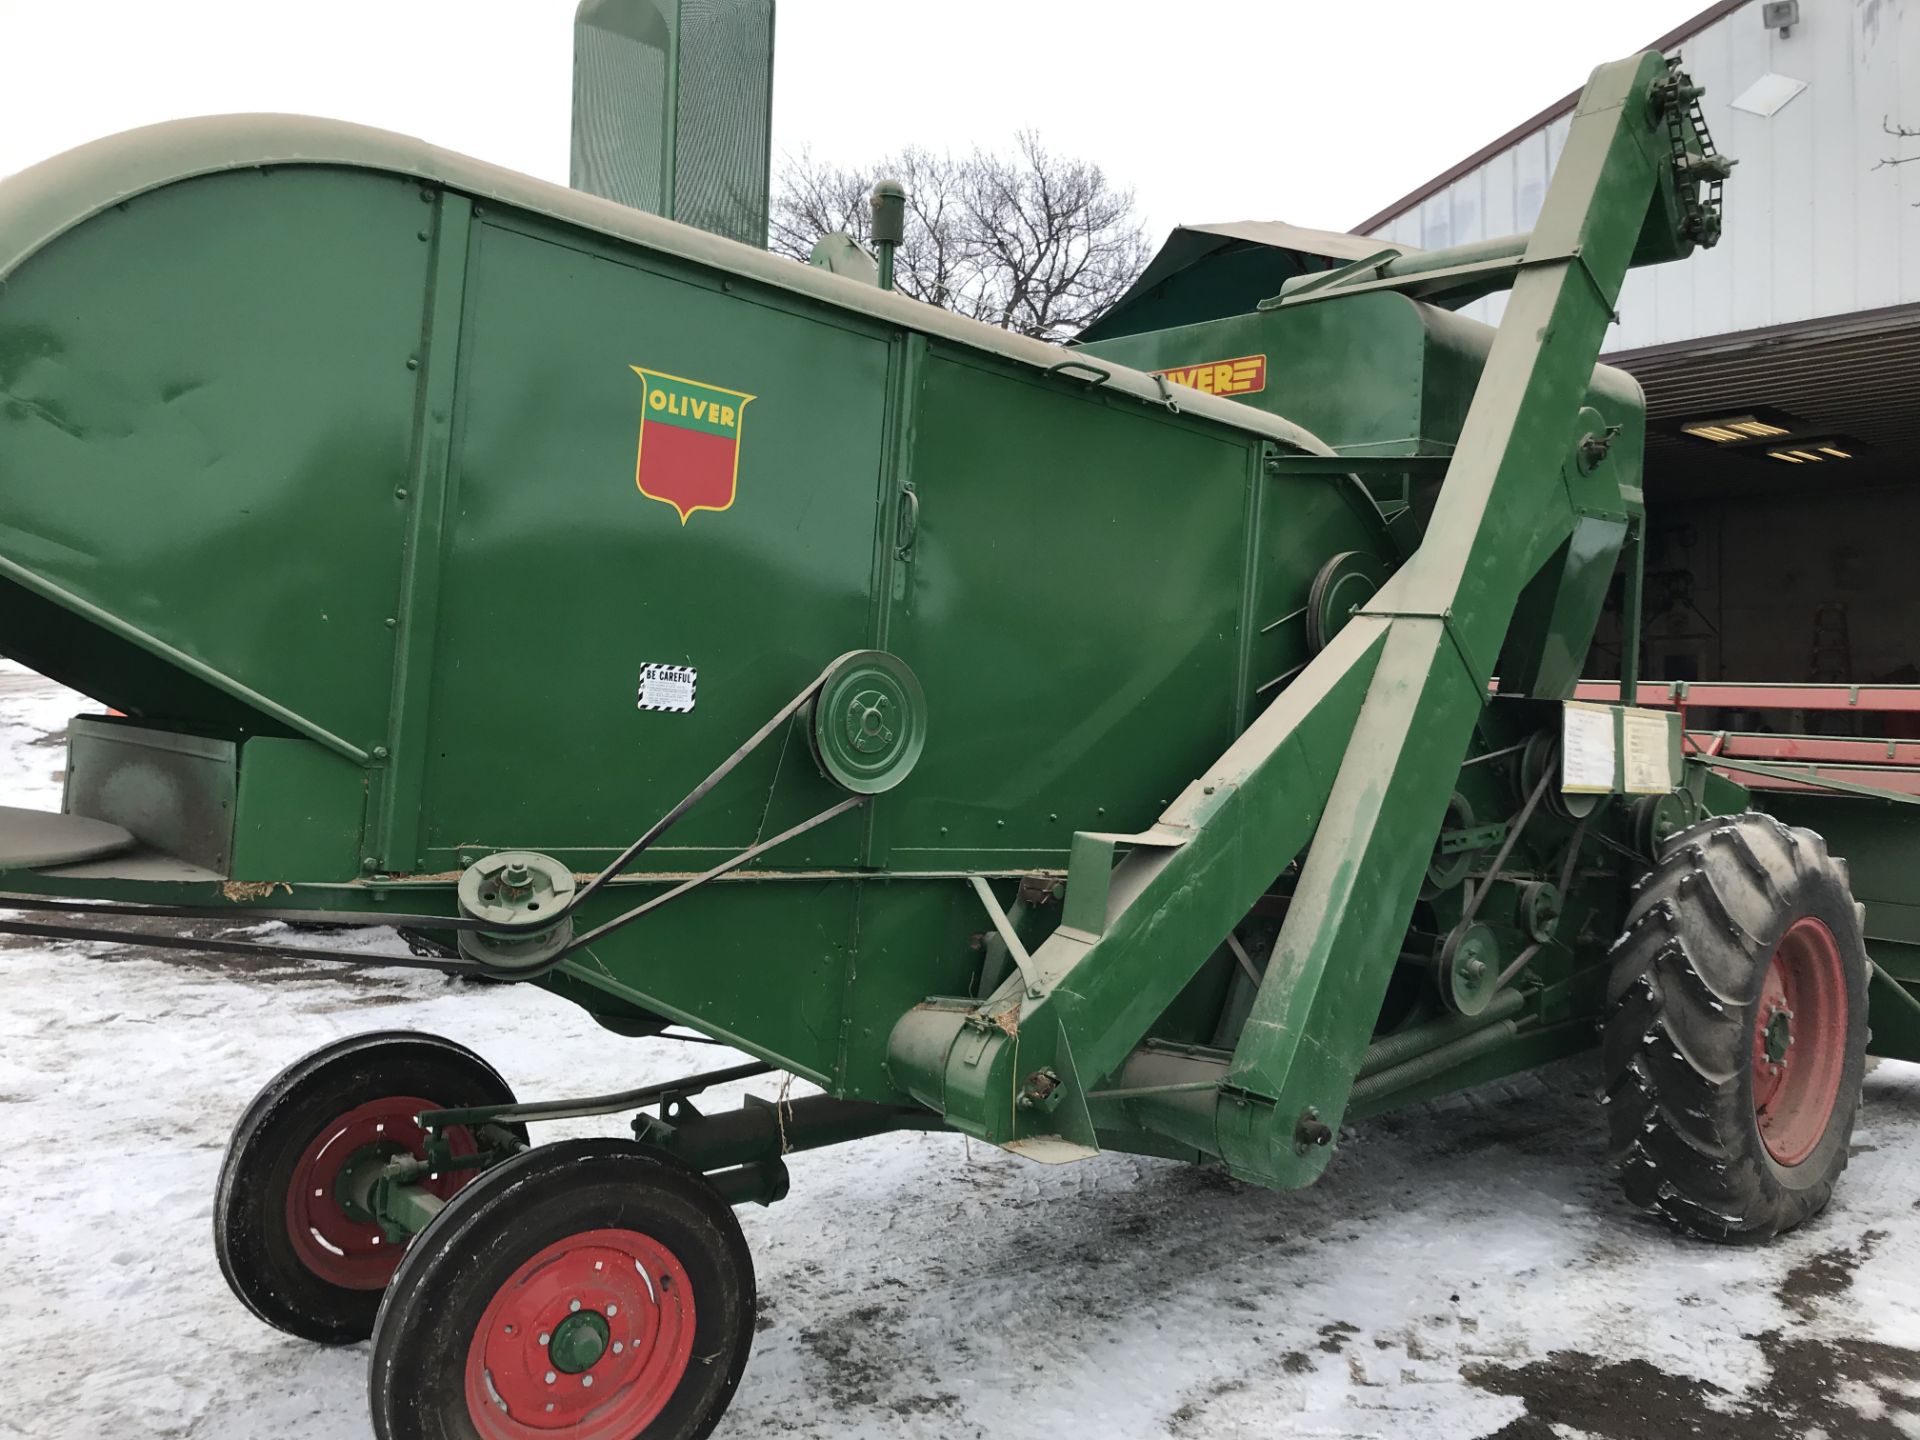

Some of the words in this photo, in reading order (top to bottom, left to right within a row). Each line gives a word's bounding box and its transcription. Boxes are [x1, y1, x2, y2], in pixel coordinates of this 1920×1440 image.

[649, 389, 735, 428] OLIVER
[646, 669, 656, 680] BE
[659, 671, 691, 684] CAREFUL
